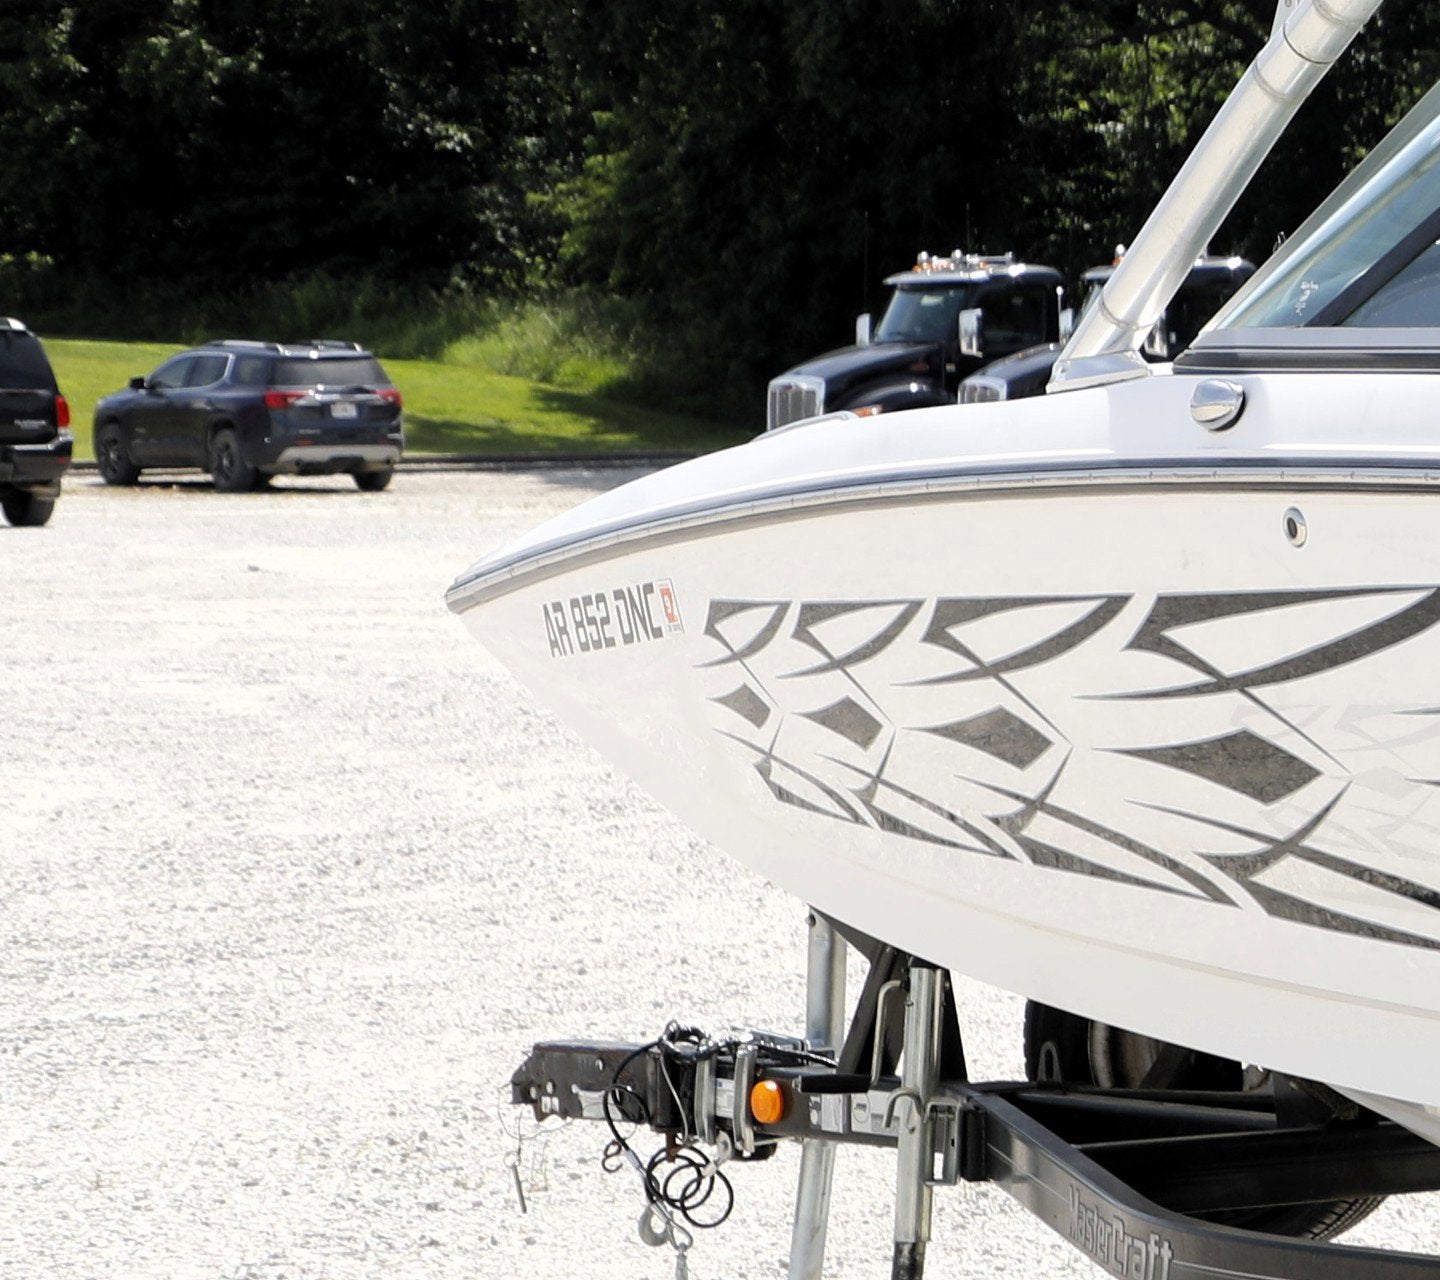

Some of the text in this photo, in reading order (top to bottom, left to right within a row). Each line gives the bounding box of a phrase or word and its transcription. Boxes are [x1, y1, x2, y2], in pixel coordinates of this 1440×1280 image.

[543, 601, 574, 658] AR
[570, 593, 616, 652] 852
[612, 582, 664, 645] DNC
